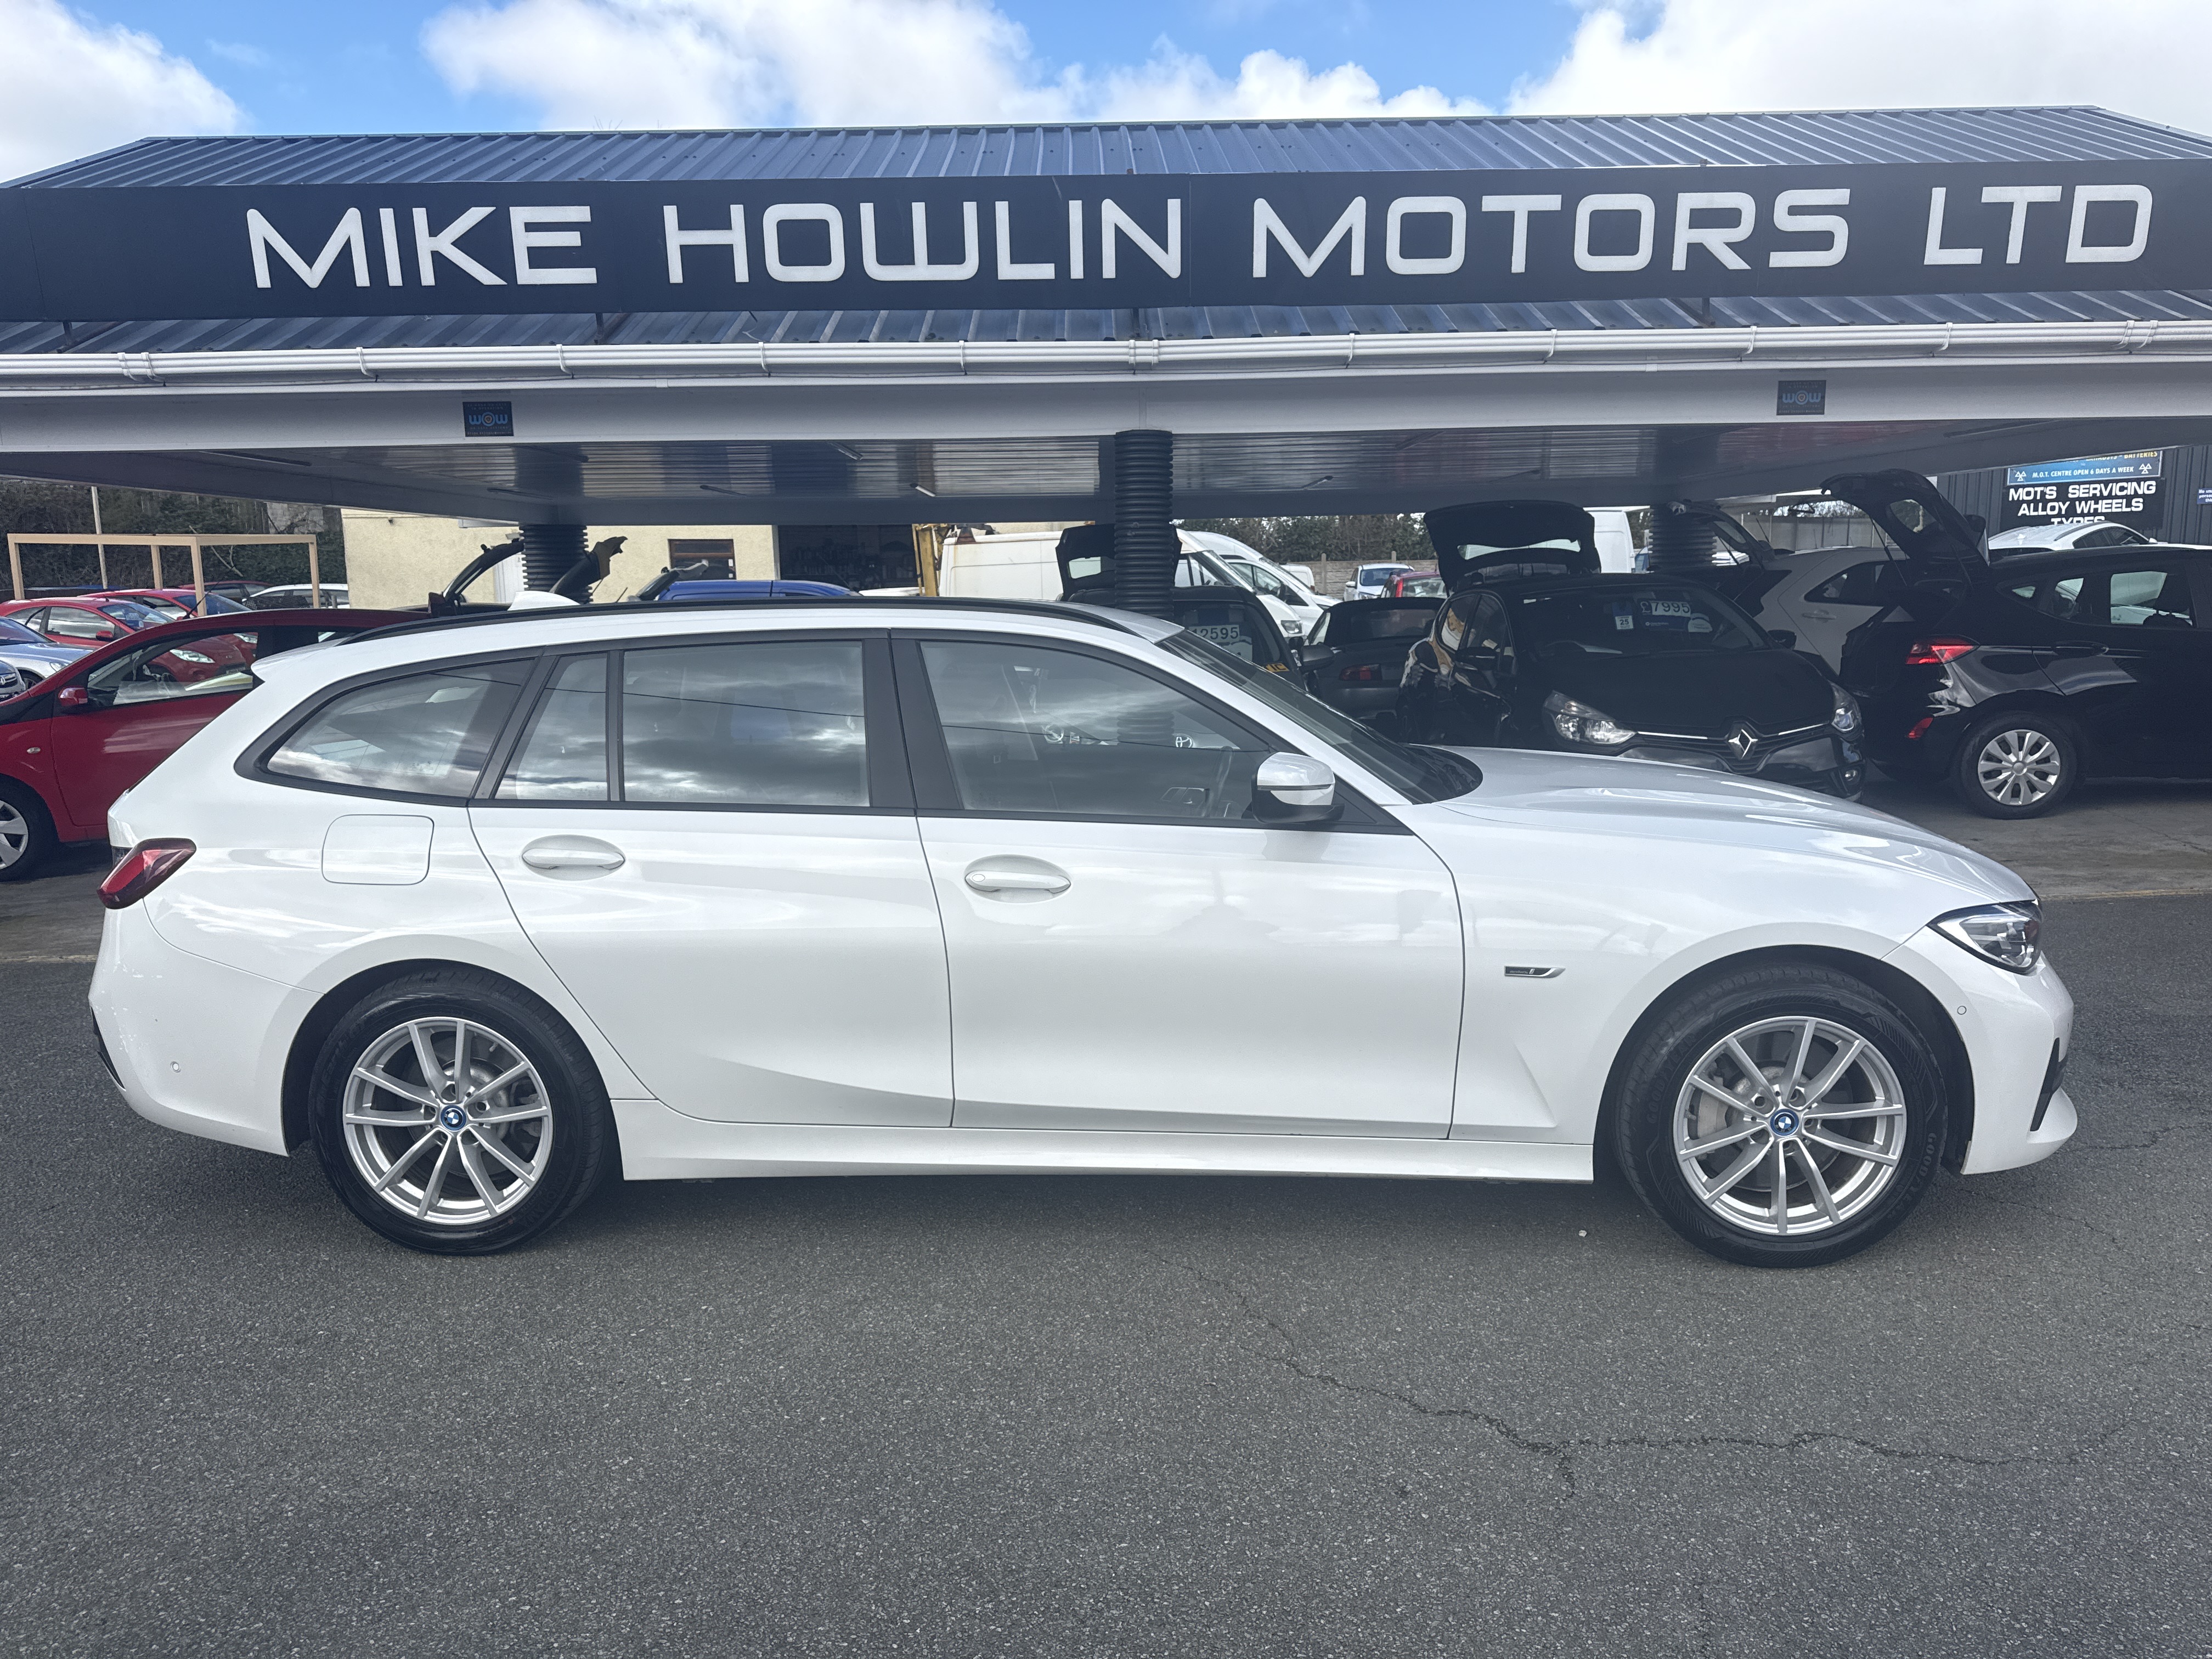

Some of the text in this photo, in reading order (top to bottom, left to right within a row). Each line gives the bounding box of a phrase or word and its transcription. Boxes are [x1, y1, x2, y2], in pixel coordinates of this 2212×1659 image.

[247, 184, 2153, 289] MIKE HOWLIN MOTORS LTD
[2008, 481, 2156, 501] MOT'S SERVICING
[2017, 498, 2143, 516] ALLOY WHEELS
[1640, 601, 1690, 614] £7995
